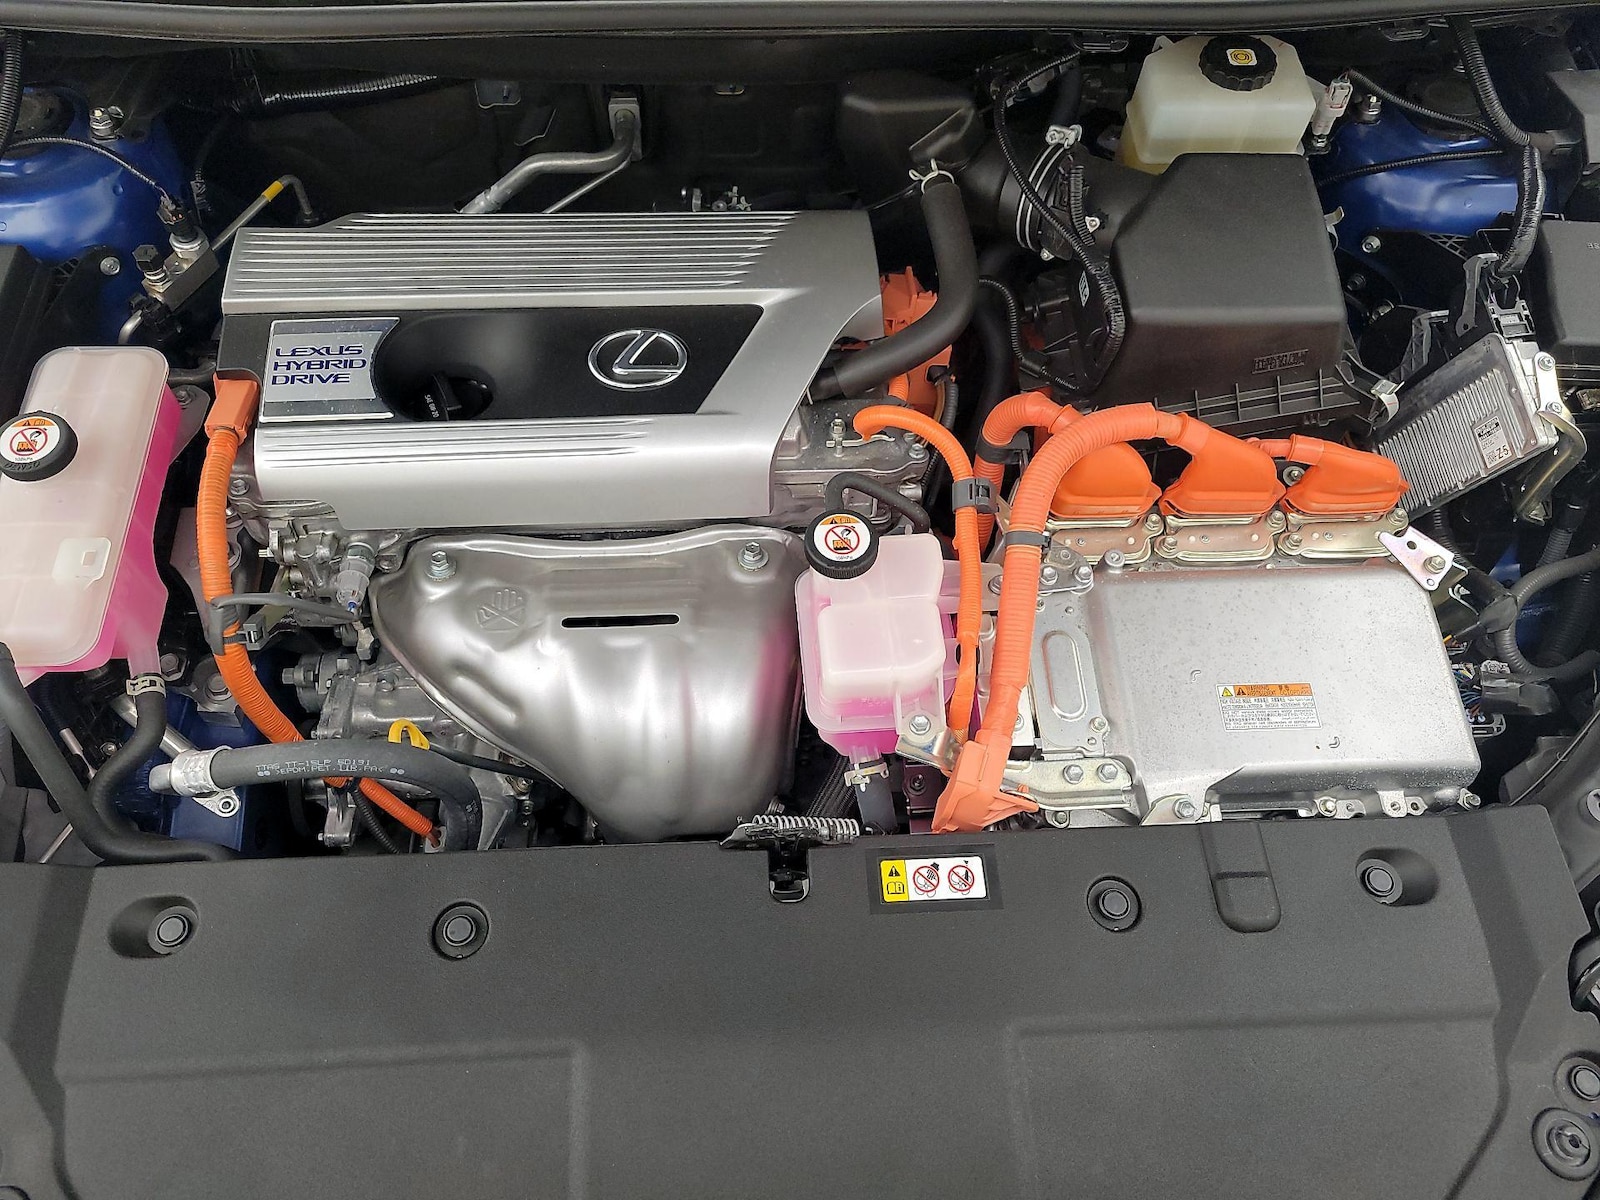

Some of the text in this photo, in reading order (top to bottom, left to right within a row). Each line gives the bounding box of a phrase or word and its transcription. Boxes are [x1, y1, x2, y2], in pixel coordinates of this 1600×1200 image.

[275, 345, 363, 357] LEXUS
[273, 358, 367, 371] HYBRID
[271, 373, 351, 386] DRIVE
[4, 460, 41, 471] DENSO
